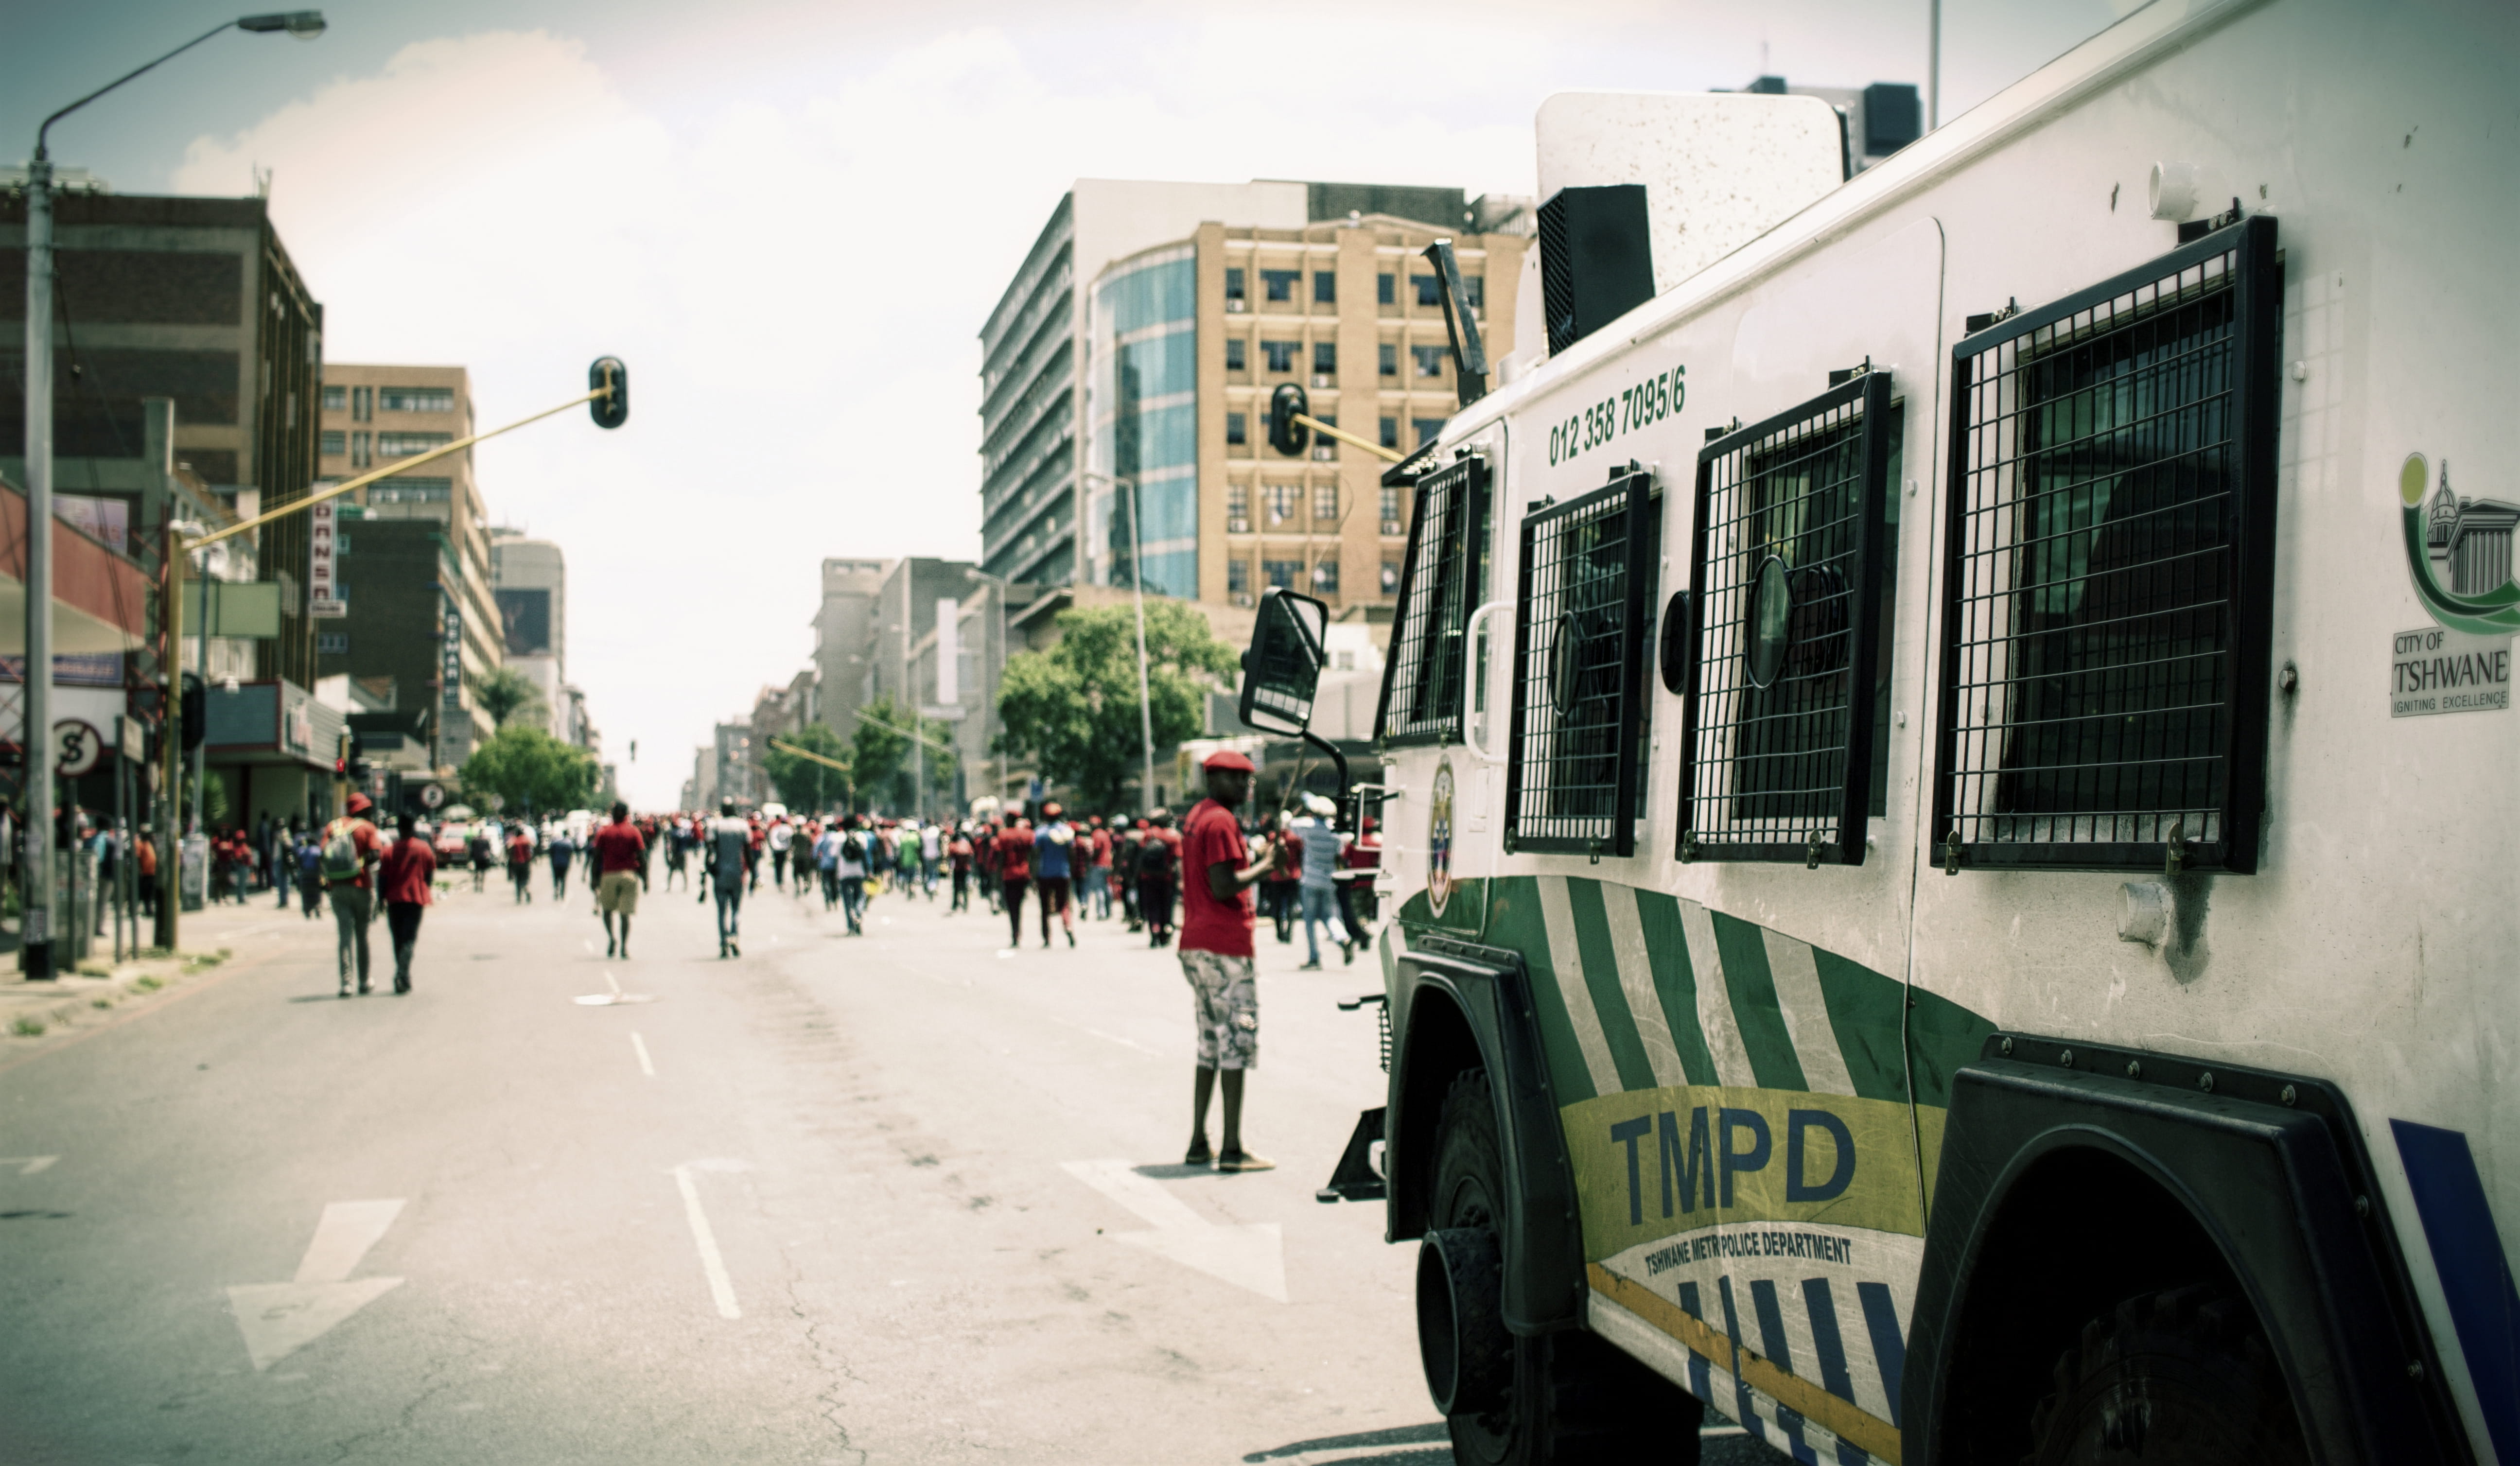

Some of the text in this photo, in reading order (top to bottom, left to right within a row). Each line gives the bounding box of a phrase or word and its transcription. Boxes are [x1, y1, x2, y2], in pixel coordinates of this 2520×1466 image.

[1550, 364, 1686, 467] 012 358 7095/6
[2395, 631, 2444, 654] CITY OF
[2394, 650, 2508, 693] TSHWANE
[2394, 691, 2507, 713] IGNITING EXCELLENCE
[58, 733, 83, 764] S
[1610, 1106, 1856, 1226] TMPD
[1645, 1232, 1851, 1276] TSHWANE METR POLICE DEPARTMENT
